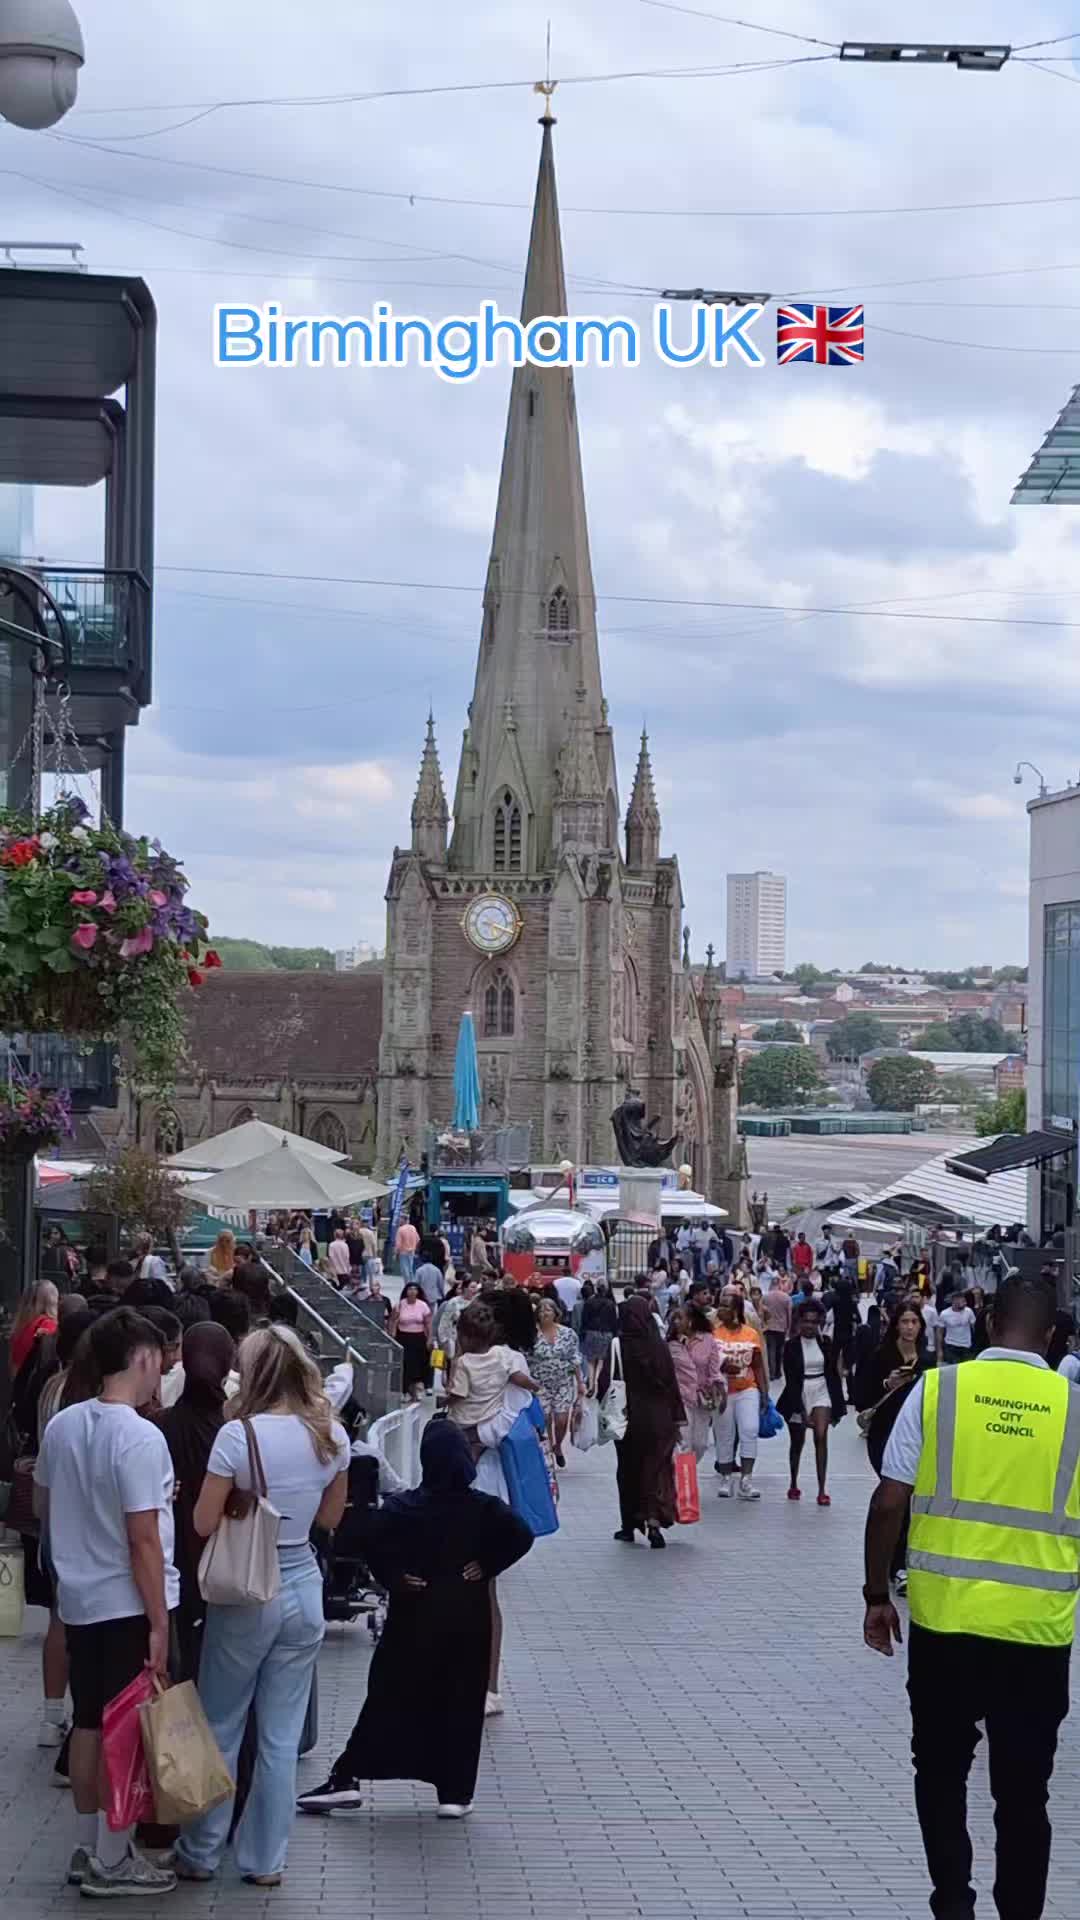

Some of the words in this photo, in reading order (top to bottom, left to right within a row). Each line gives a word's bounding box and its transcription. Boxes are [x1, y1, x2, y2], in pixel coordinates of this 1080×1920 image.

[974, 1394, 1052, 1414] BIRMINGHAM
[999, 1411, 1023, 1422] CITY
[985, 1422, 1036, 1438] COUNCIL
